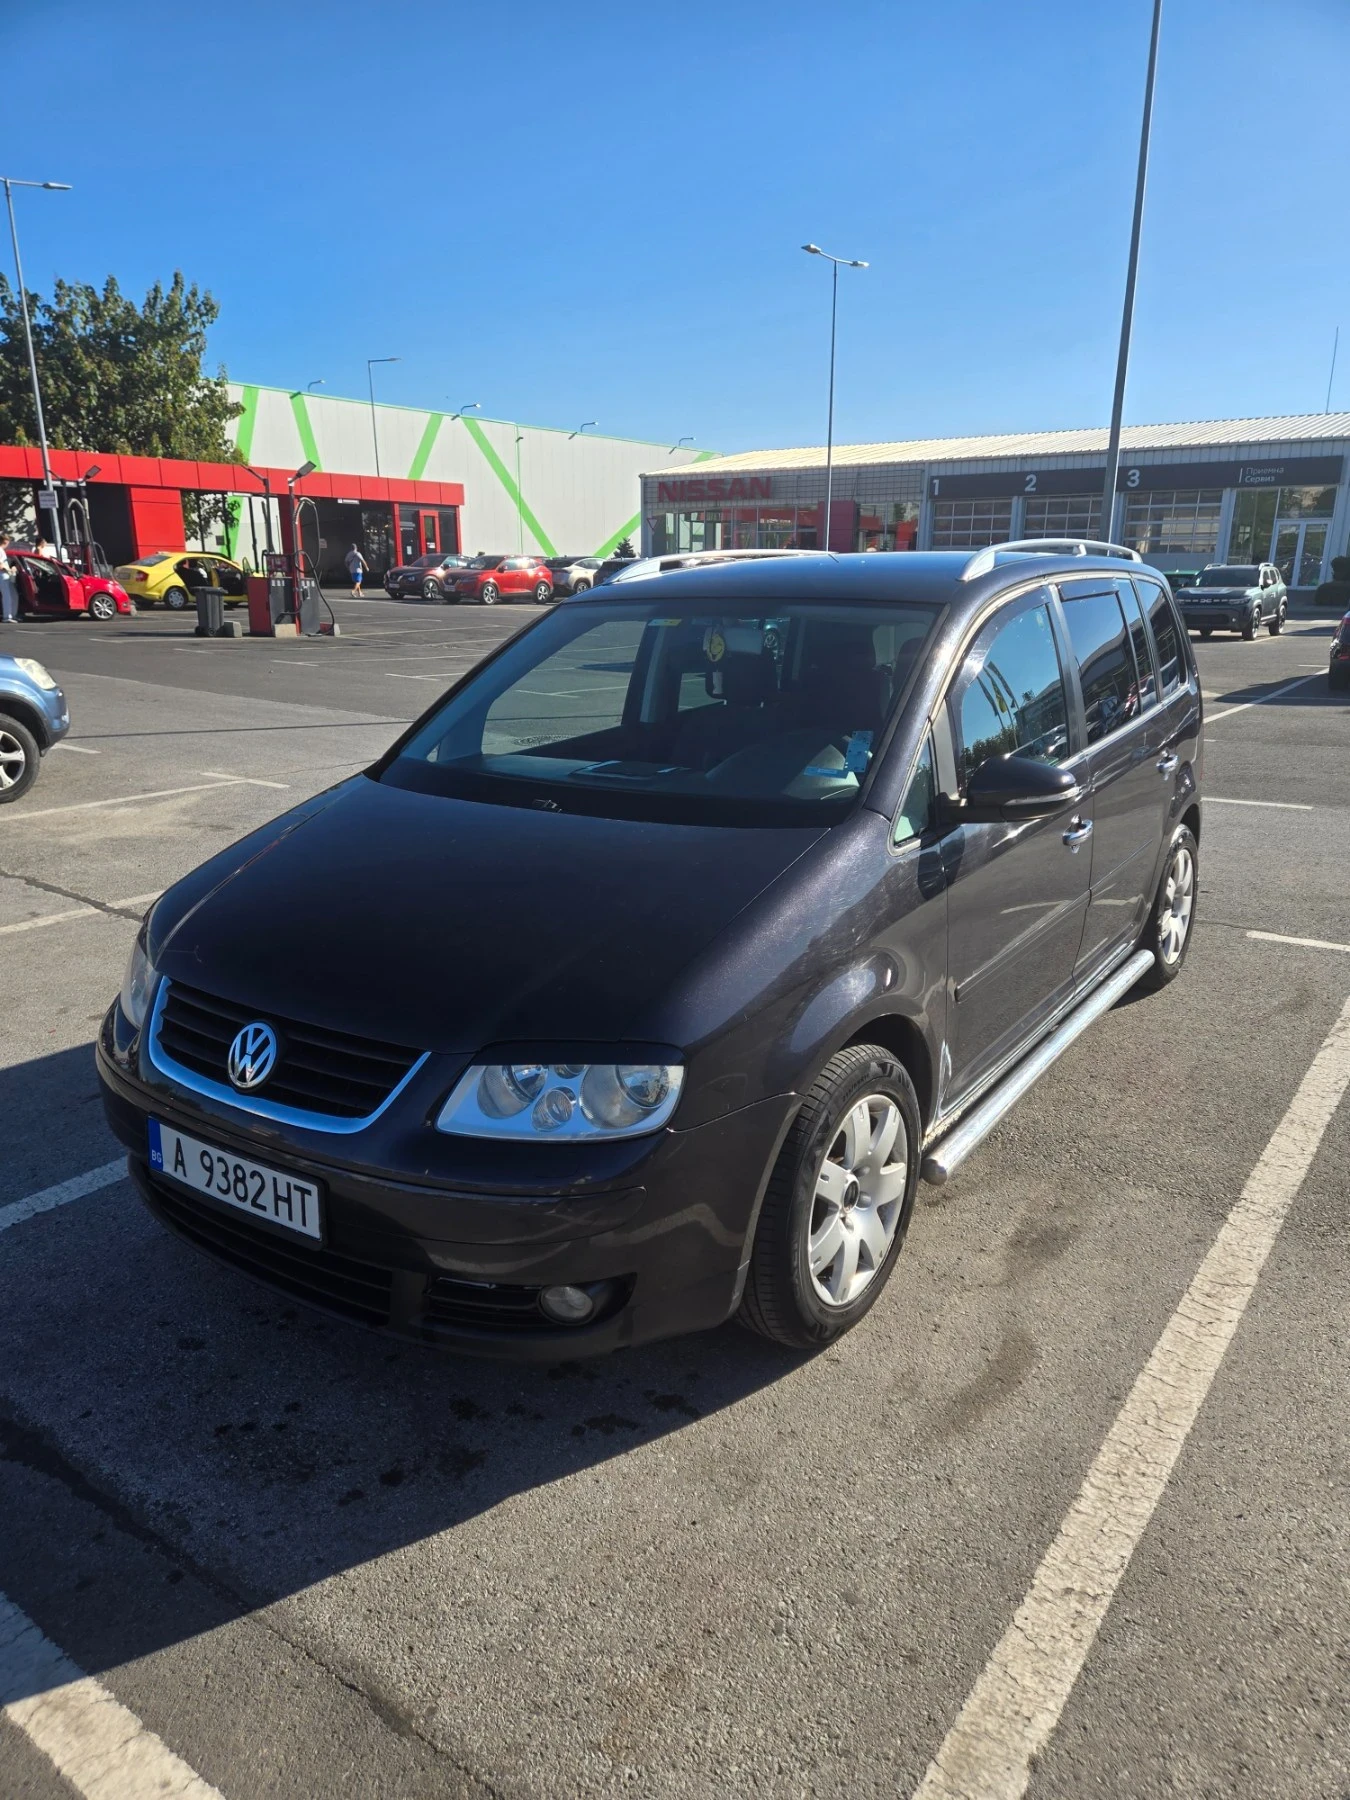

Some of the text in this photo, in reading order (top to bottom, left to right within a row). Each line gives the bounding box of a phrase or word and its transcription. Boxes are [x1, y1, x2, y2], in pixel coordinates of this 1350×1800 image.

[932, 479, 940, 496] 1
[1024, 474, 1037, 492] 2
[1127, 469, 1140, 488] 3
[1244, 475, 1275, 484] Сервиз
[657, 476, 772, 501] NISSAN
[151, 1149, 163, 1164] BG
[173, 1137, 187, 1178] A
